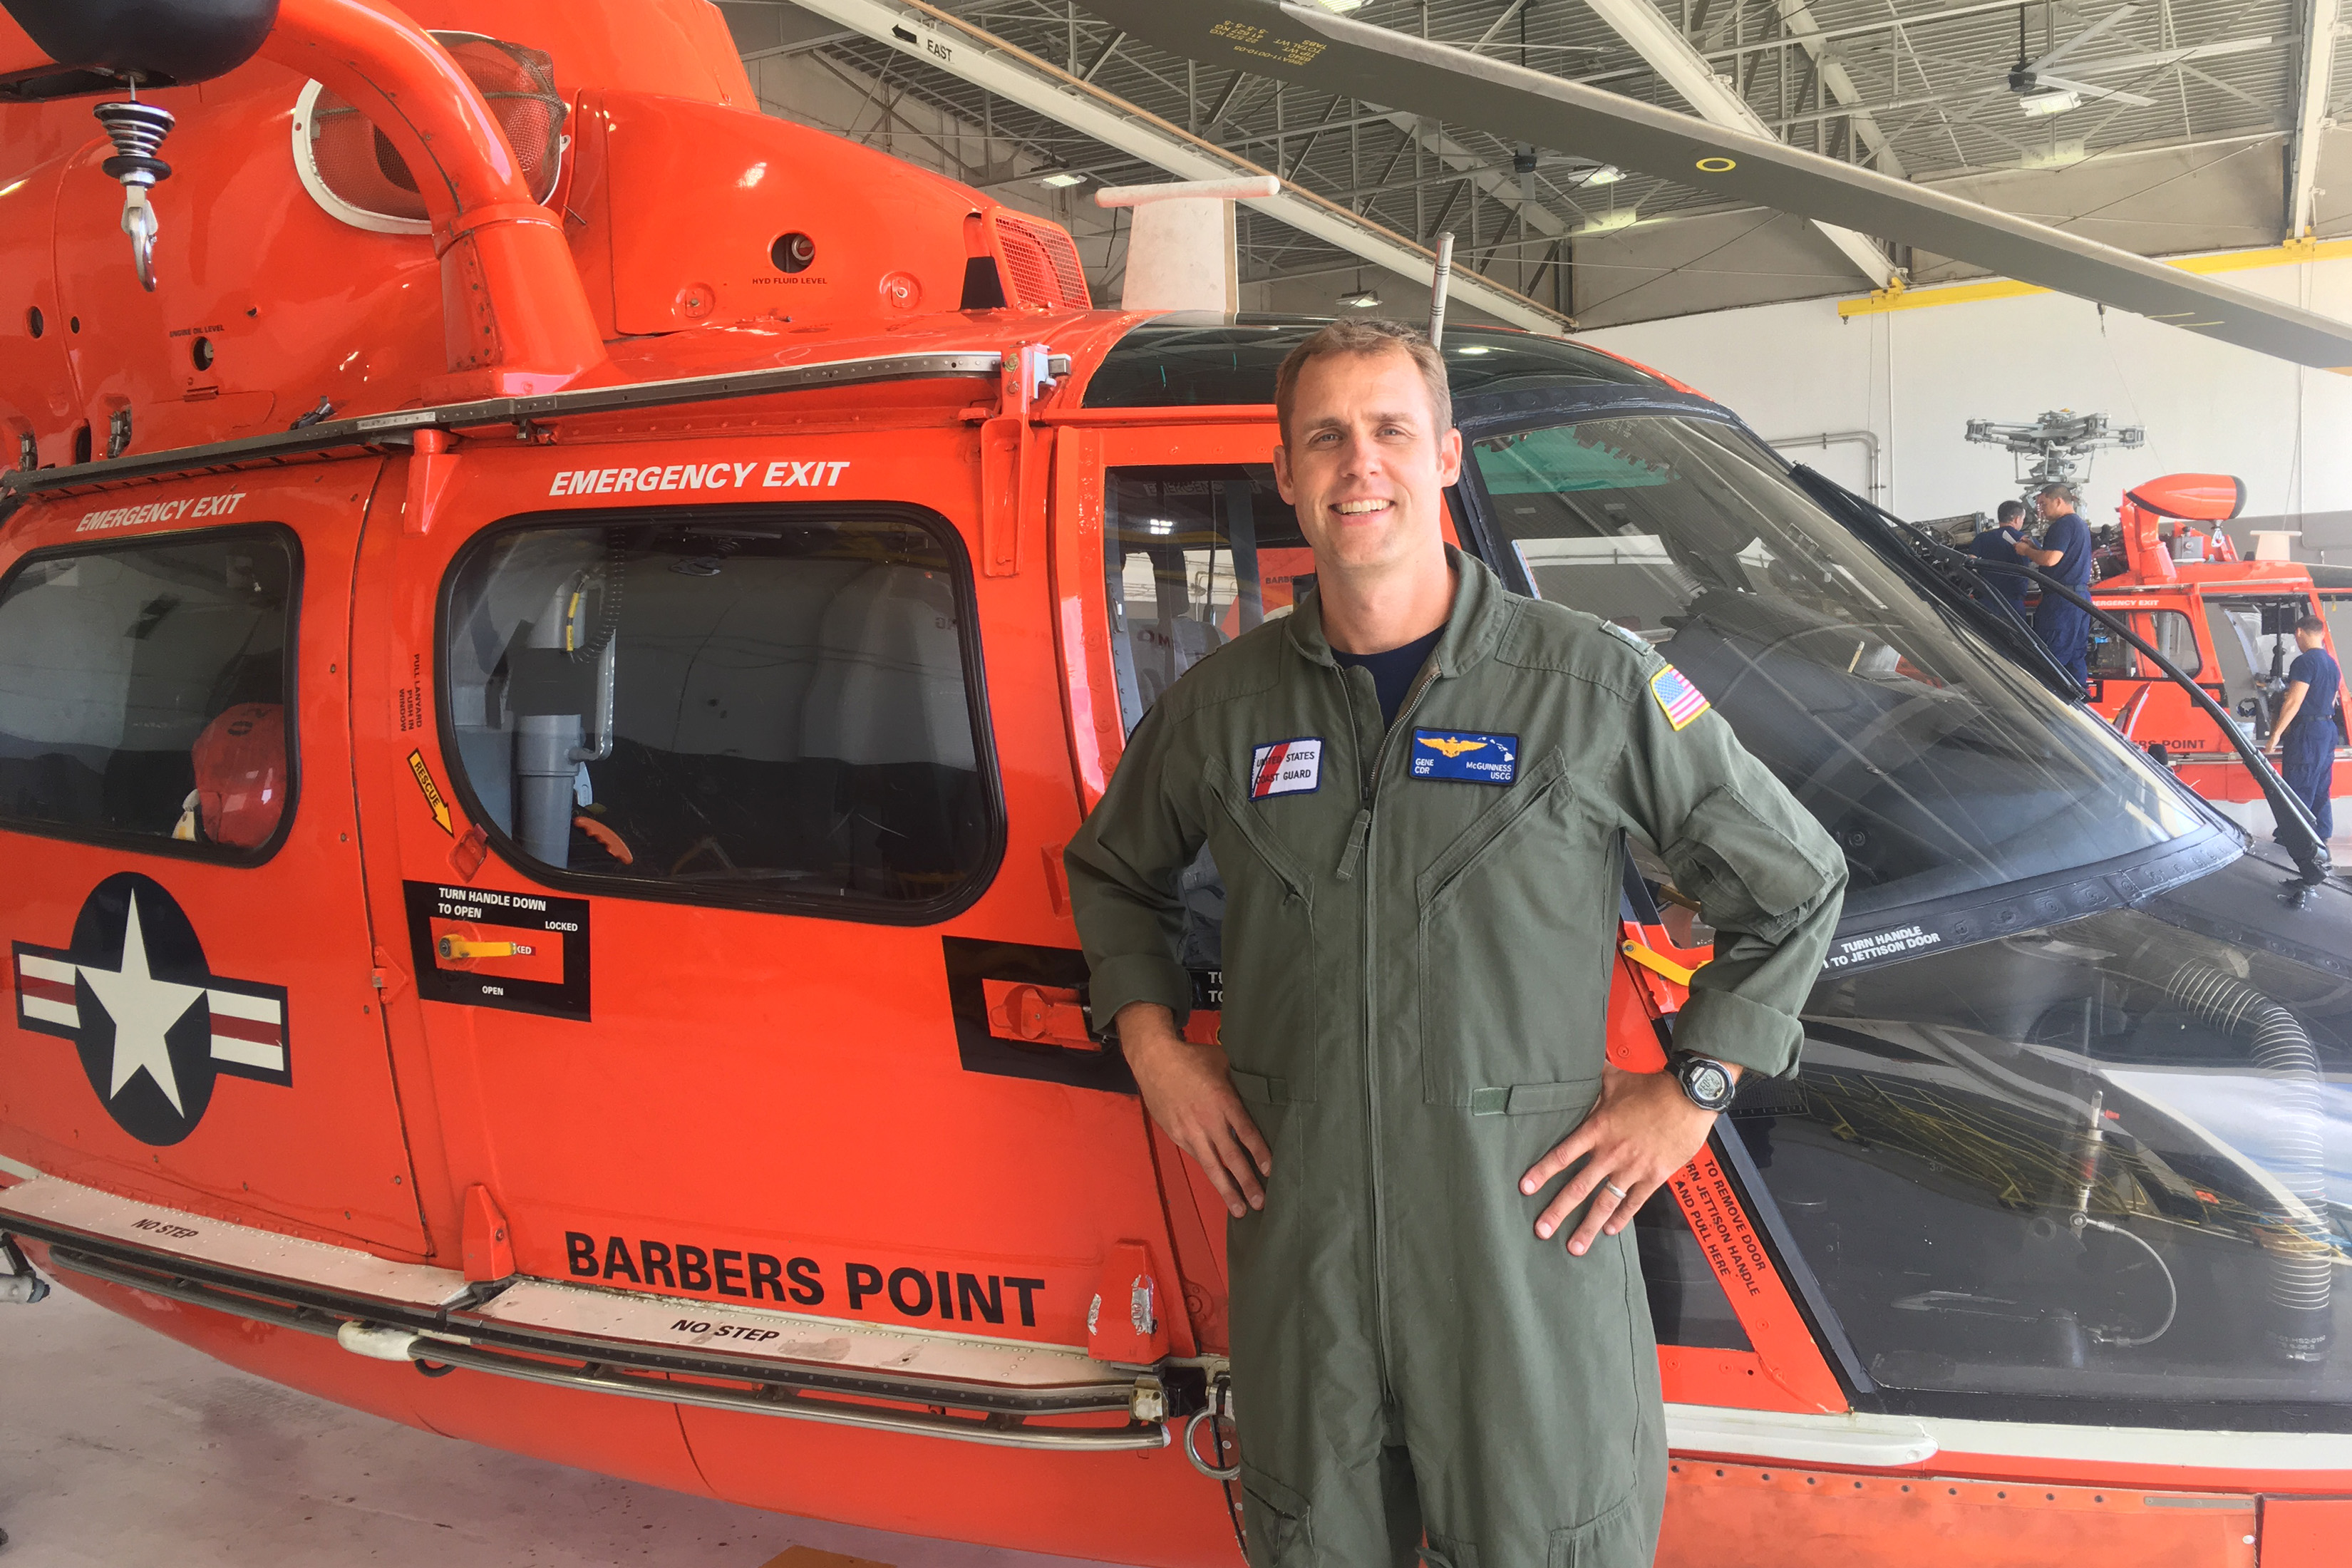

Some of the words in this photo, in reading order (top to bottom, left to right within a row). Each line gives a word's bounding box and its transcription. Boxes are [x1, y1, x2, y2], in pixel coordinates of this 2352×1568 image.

[927, 38, 952, 61] EAST
[1293, 43, 1322, 54] TOTAL
[1302, 39, 1327, 50] TABS
[170, 329, 191, 337] ENGINE
[205, 324, 225, 333] LEVEL
[549, 463, 758, 496] EMERGENCY
[762, 461, 850, 487] EXIT
[76, 499, 194, 532] EMERGENCY
[191, 492, 246, 517] EXIT
[1265, 575, 1294, 584] BARBE
[408, 719, 414, 731] IN
[2162, 740, 2205, 749] POINT
[1286, 751, 1315, 762] STATES
[1415, 758, 1434, 766] GENE
[1466, 761, 1512, 772] McGUINNESS
[1283, 769, 1311, 780] GUARD
[1490, 772, 1511, 780] USCG
[414, 761, 440, 807] RESCUE
[438, 887, 466, 901] TURN
[468, 891, 510, 907] HANDLE
[512, 897, 546, 912] DOWN
[438, 903, 452, 914] TO
[454, 905, 482, 919] OPEN
[545, 921, 578, 932] LOCKED
[1841, 937, 1875, 954] TURN
[1875, 926, 1923, 945] HANDLE
[516, 945, 532, 954] KED
[1830, 955, 1848, 966] TO
[1851, 942, 1906, 963] JETTISON
[1907, 933, 1941, 949] DOOR
[482, 986, 504, 996] OPEN
[1705, 1159, 1718, 1178] TO
[1713, 1179, 1747, 1233] REMOVE
[1741, 1234, 1766, 1271] DOOR
[130, 1218, 161, 1230] NO
[155, 1224, 199, 1239] STEP
[1675, 1180, 1695, 1209] AND
[1691, 1210, 1712, 1243] PULL
[1708, 1244, 1731, 1276] HERE
[1686, 1160, 1701, 1182] RN
[1696, 1185, 1733, 1244] JETTISON
[1728, 1245, 1760, 1296] HANDLE
[564, 1230, 825, 1306] BARBERS
[845, 1262, 1045, 1327] POINT
[670, 1319, 711, 1334] NO
[713, 1325, 780, 1342] STEP
